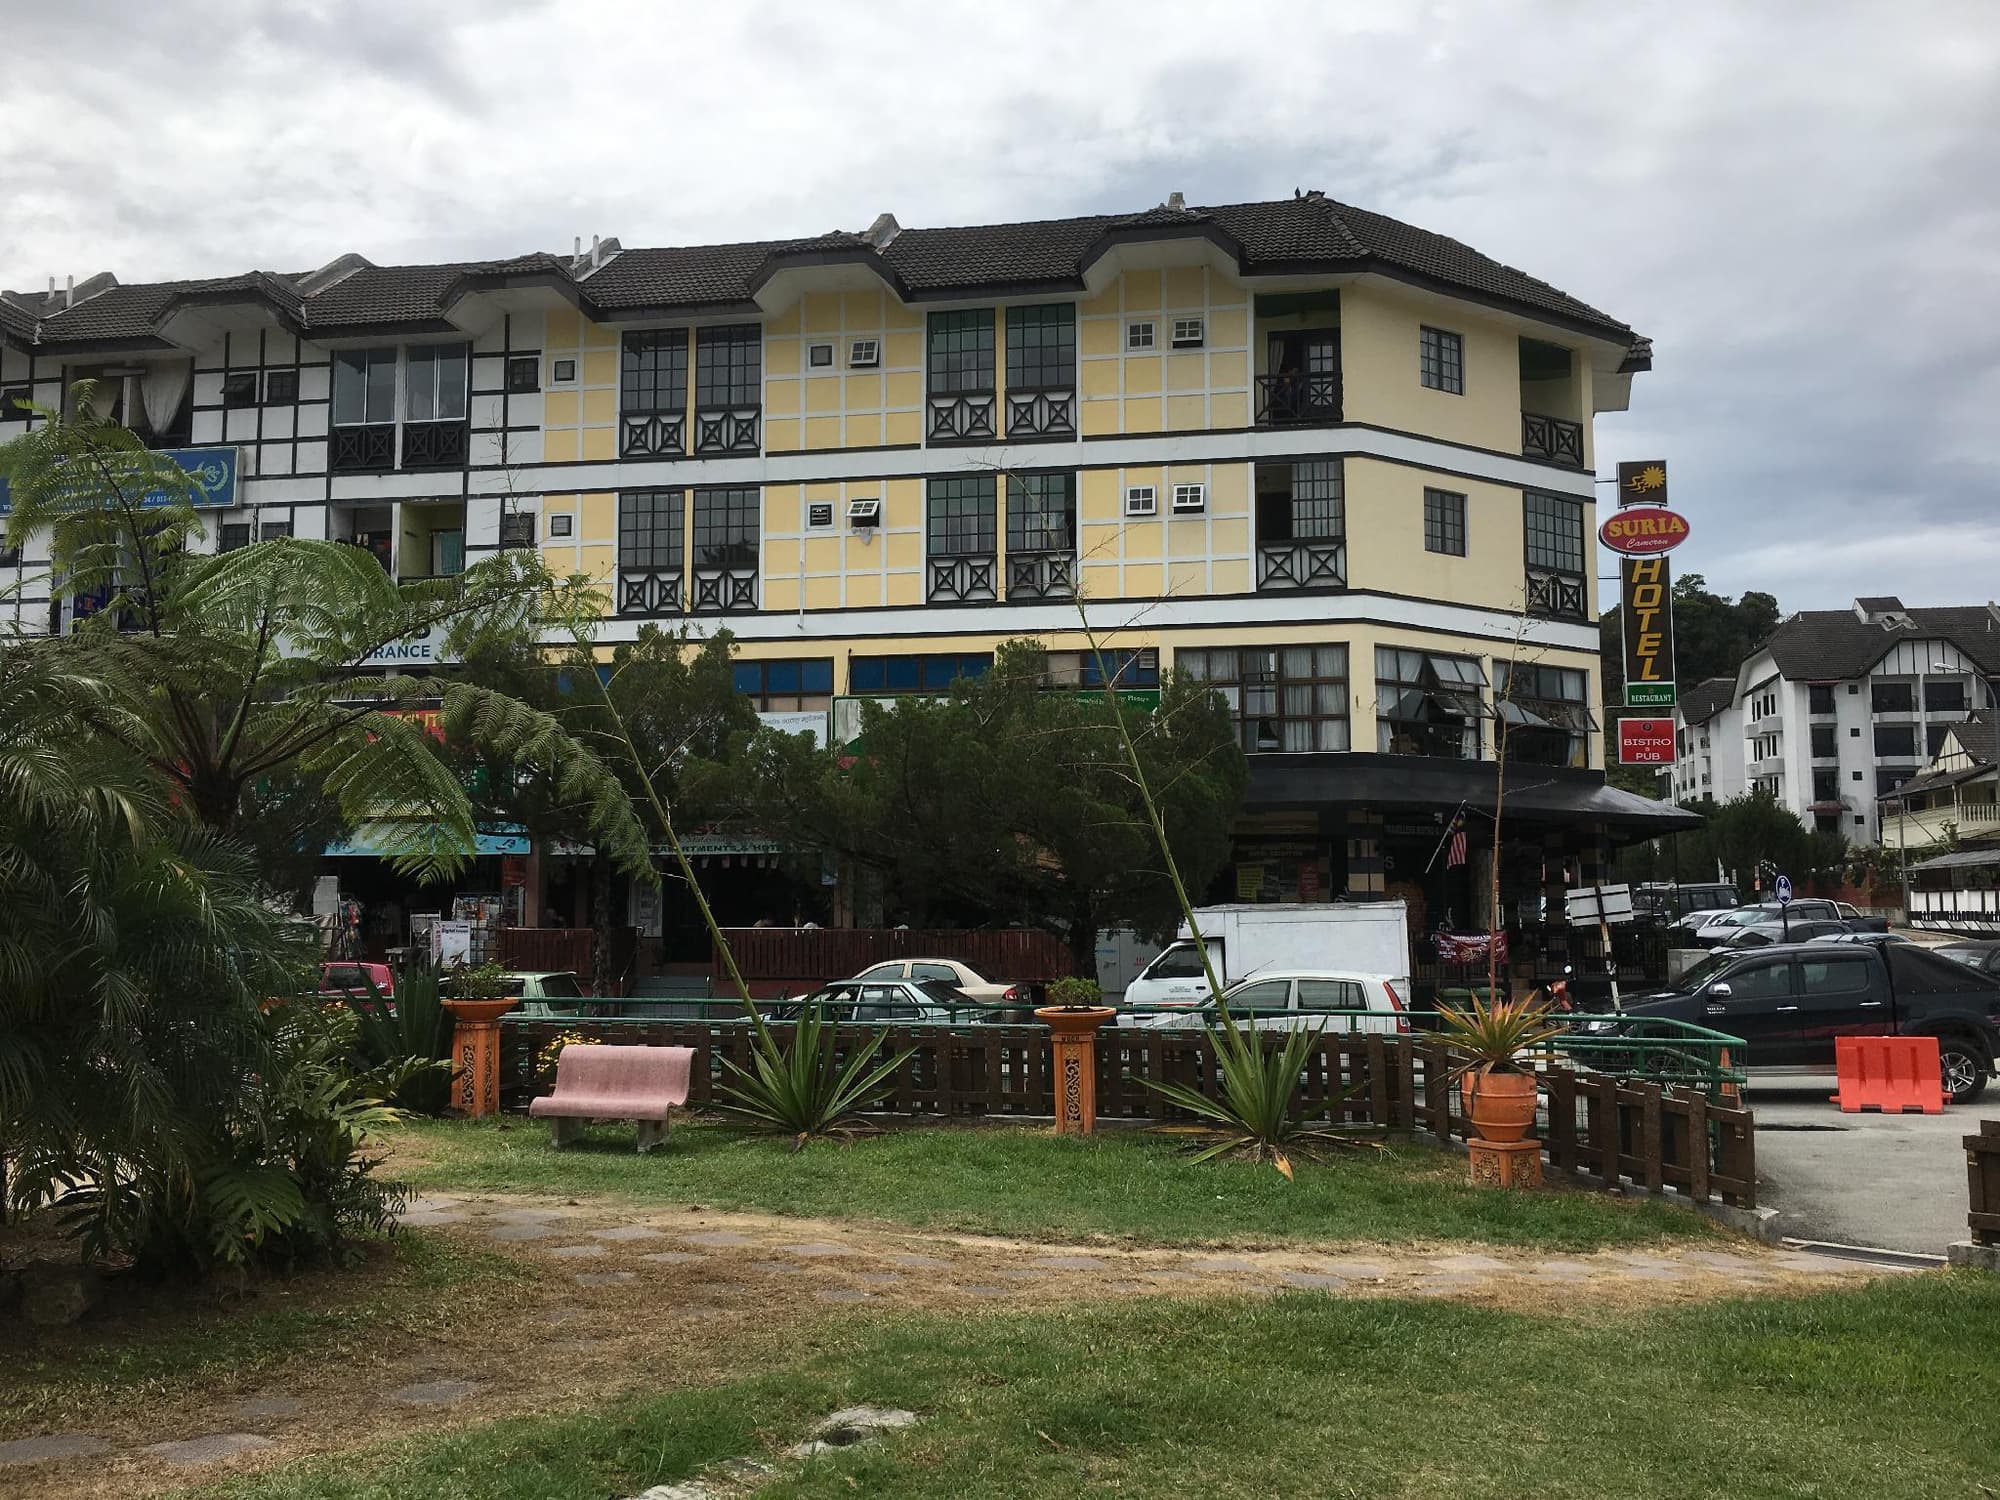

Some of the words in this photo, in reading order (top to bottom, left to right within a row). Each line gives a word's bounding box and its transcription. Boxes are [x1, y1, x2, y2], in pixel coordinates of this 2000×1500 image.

[1608, 516, 1685, 537] SURIA
[1626, 538, 1668, 548] Cameron
[1631, 559, 1662, 681] HOTEL
[367, 645, 431, 659] RANCE
[1631, 694, 1672, 703] RESTAURANT
[1623, 738, 1672, 746] BISTRO
[1635, 752, 1660, 760] PUB
